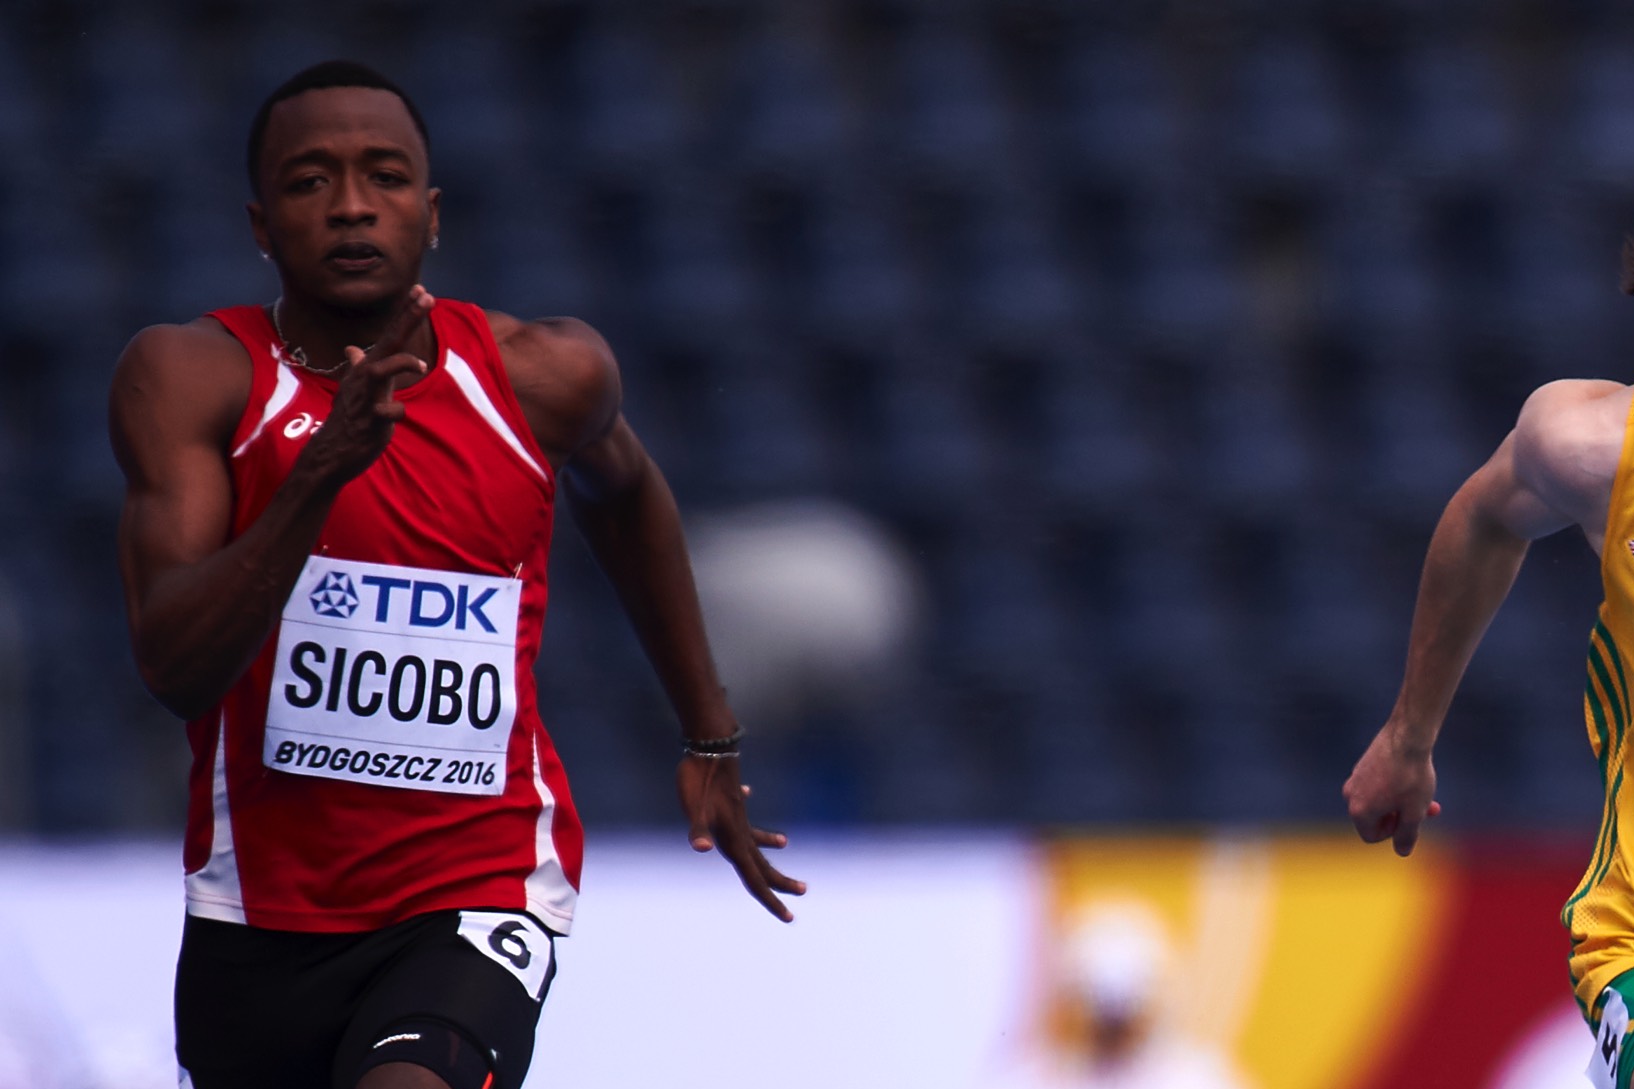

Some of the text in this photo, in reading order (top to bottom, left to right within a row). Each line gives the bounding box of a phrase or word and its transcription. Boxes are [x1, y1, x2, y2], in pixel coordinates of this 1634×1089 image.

[361, 574, 500, 634] TDK
[284, 640, 501, 730] SICOBO
[274, 740, 496, 785] BYDGOSZCZ 2016
[488, 921, 531, 970] 6
